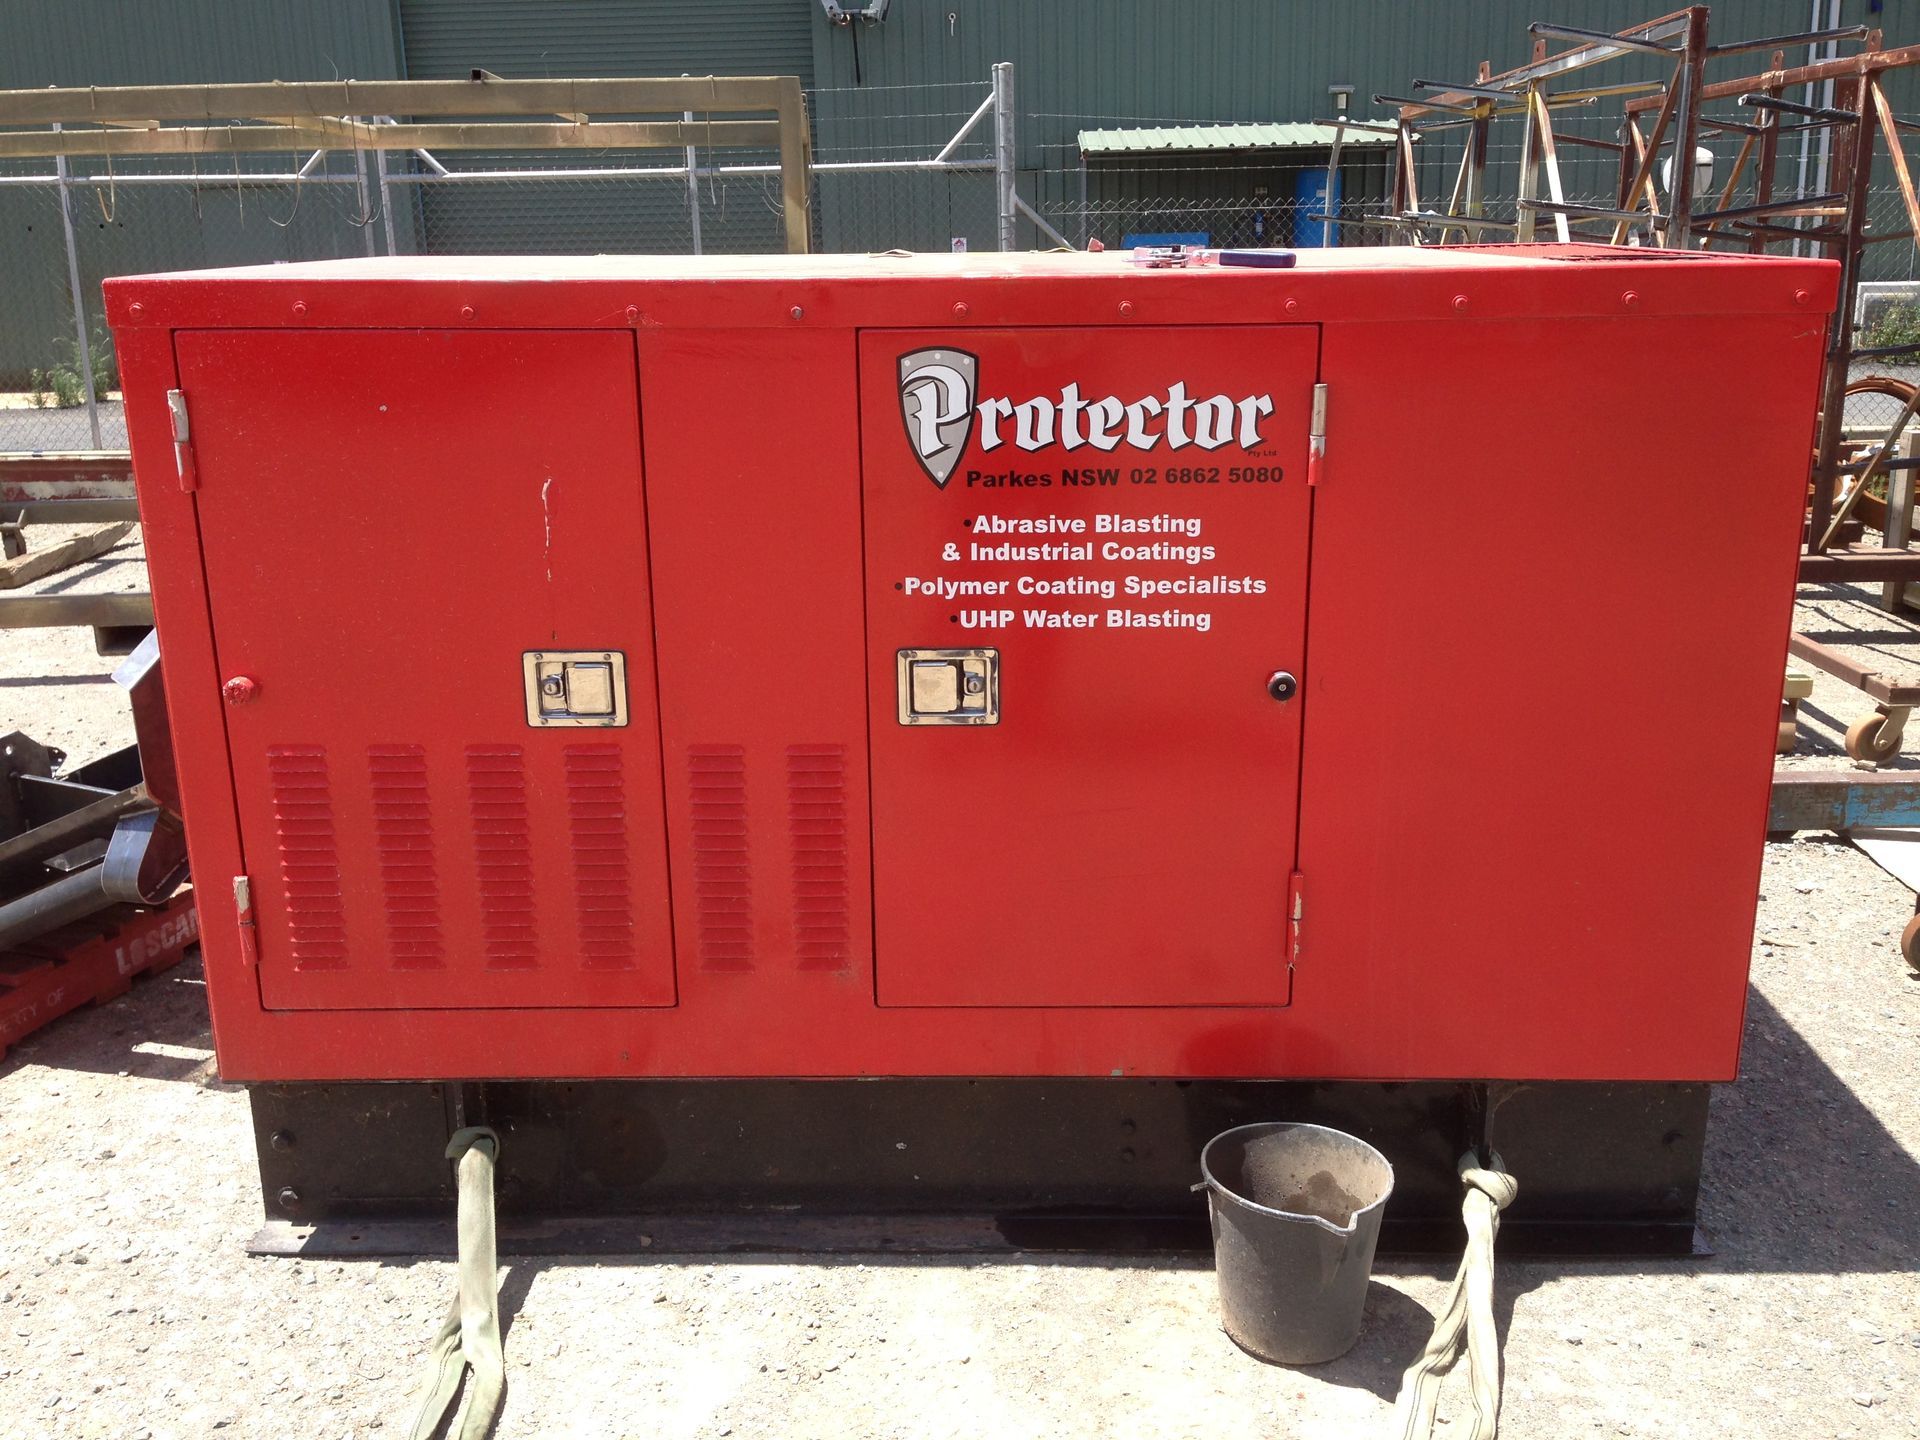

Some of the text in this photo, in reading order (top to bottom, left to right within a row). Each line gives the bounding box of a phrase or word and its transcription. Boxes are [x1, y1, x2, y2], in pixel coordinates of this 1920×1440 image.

[902, 364, 1274, 459] Protector
[1248, 450, 1261, 458] Pty
[966, 466, 1284, 488] Parkes NSW 02 6862 5080
[972, 514, 1202, 537] Abrasive Blasting
[942, 542, 1216, 565] & Industrial Coatings
[905, 575, 1267, 599] Polymer Coating Specialists
[960, 609, 1211, 631] UHP Water Blasting
